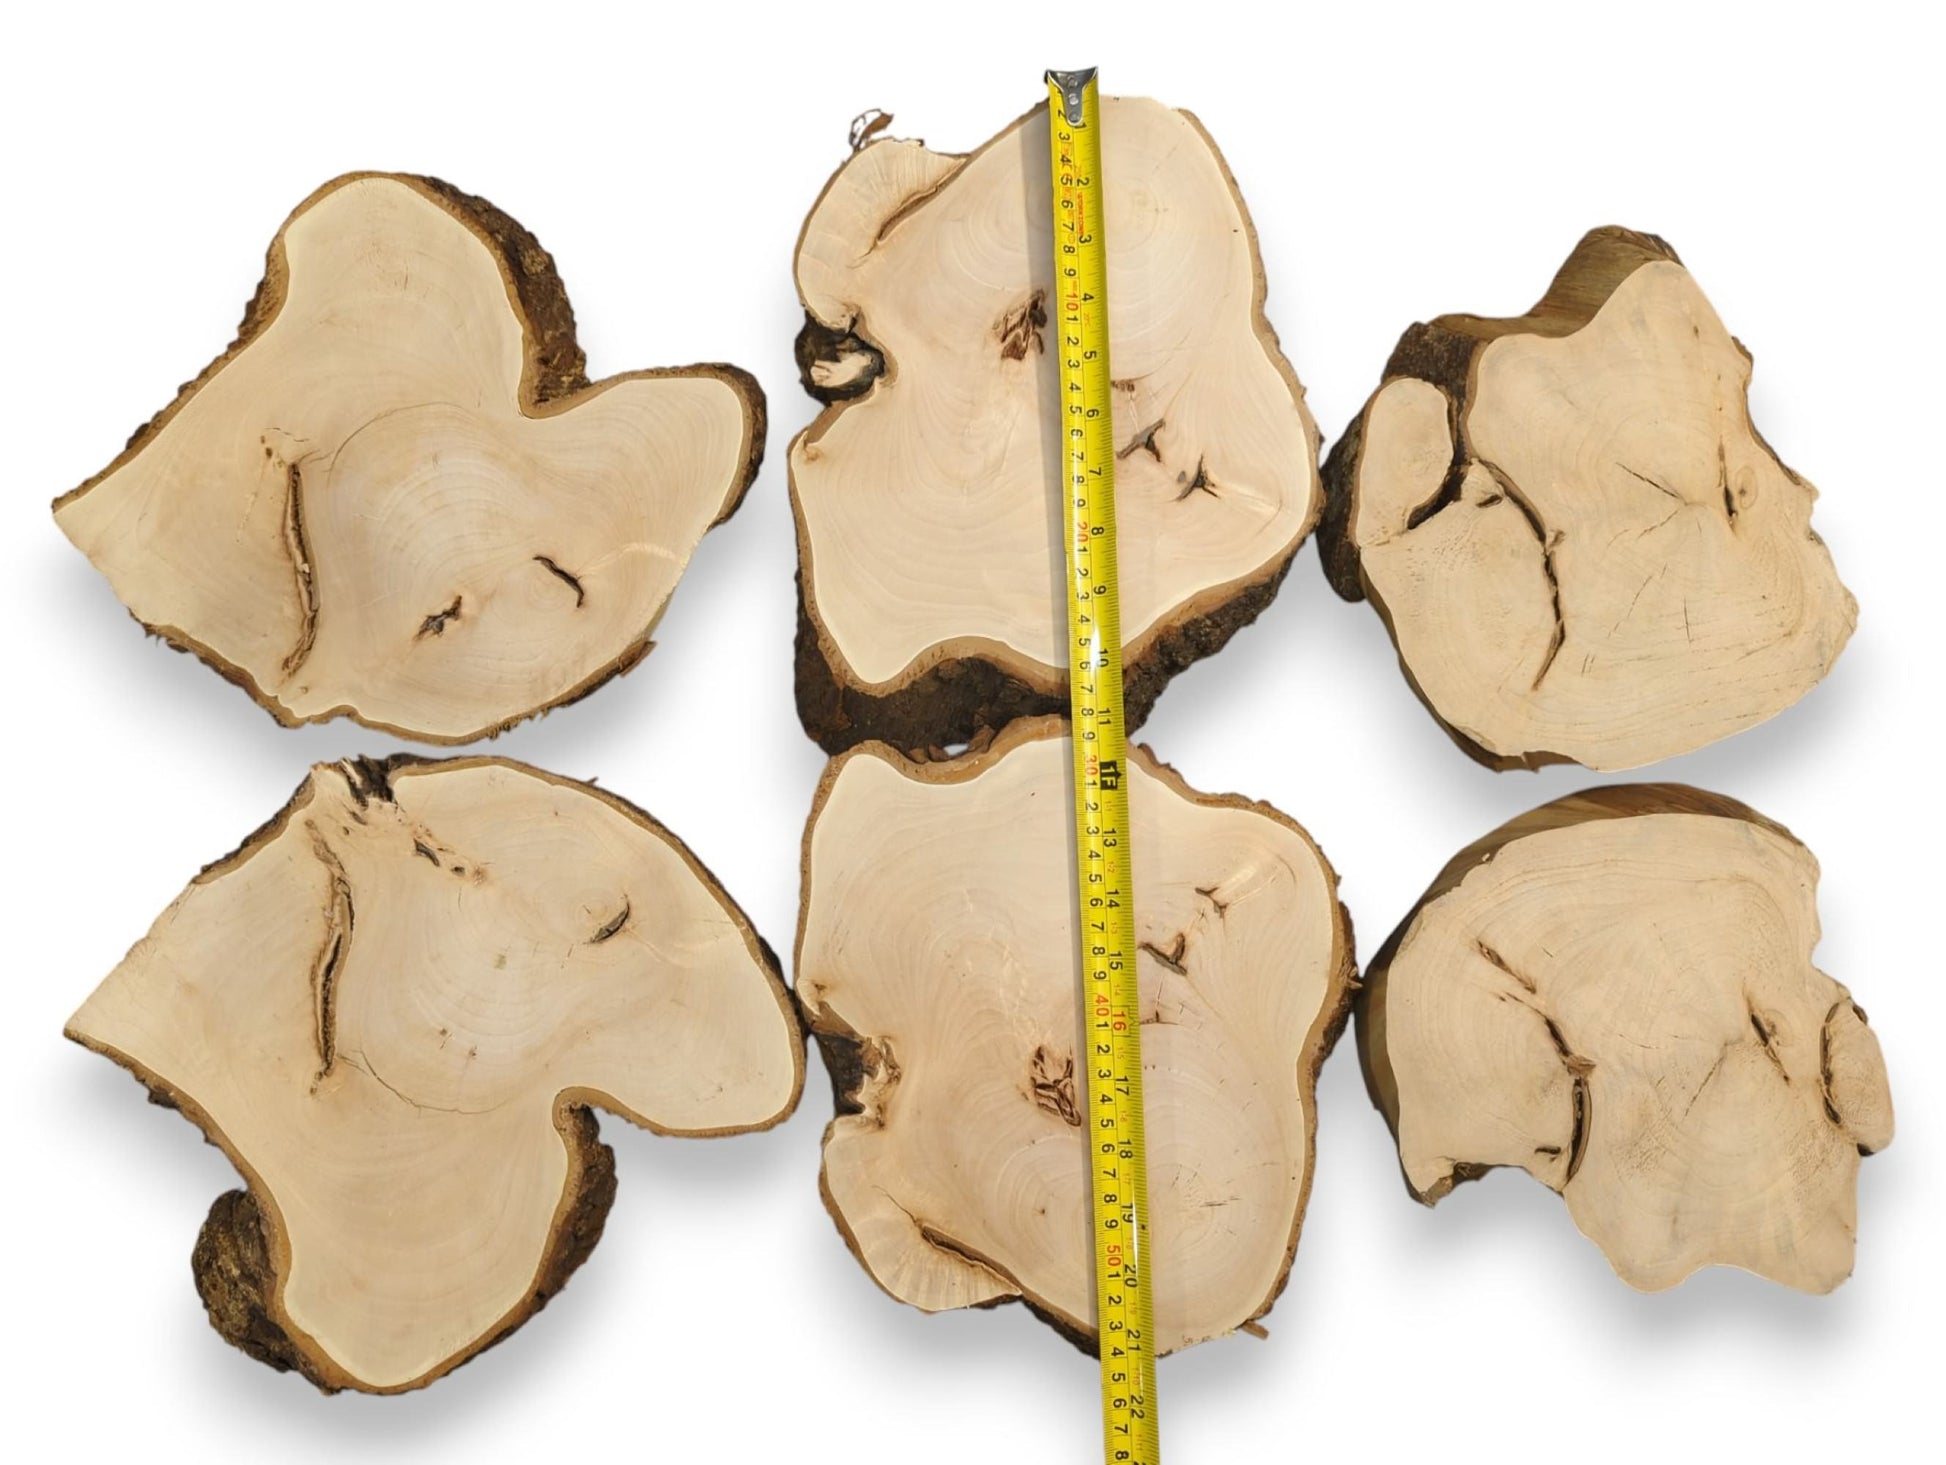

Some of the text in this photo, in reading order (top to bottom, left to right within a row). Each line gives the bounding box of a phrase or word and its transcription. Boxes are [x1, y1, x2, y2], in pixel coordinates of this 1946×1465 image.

[1058, 109, 1066, 120] 2
[1059, 133, 1070, 141] 3
[1060, 154, 1072, 164] 4
[1061, 177, 1072, 185] 5
[1077, 177, 1089, 186] 2
[1062, 200, 1073, 209] 6
[1063, 222, 1074, 232] 7
[1079, 235, 1091, 243] 3
[1064, 245, 1075, 253] 8
[1064, 269, 1076, 277] 9
[1082, 293, 1094, 301] 4
[1066, 293, 1078, 311] 10
[1067, 337, 1079, 345] 2
[1084, 351, 1096, 359] 5
[1068, 360, 1080, 368] 3
[1069, 383, 1081, 391] 4
[1070, 406, 1082, 414] 5
[1086, 409, 1099, 418] 6
[1071, 429, 1083, 437] 6
[1072, 452, 1083, 460] 7
[1089, 467, 1101, 475] 7
[1073, 499, 1086, 507] 9
[1077, 522, 1088, 542] 20
[1092, 526, 1104, 535] 8
[1077, 568, 1088, 576] 2
[1094, 585, 1106, 594] 9
[1077, 592, 1089, 600] 3
[1079, 615, 1091, 624] 4
[1079, 638, 1091, 646] 5
[1097, 649, 1109, 667] 10
[1080, 662, 1091, 670] 6
[1081, 685, 1093, 693] 7
[1082, 708, 1094, 716] 8
[1098, 708, 1111, 725] 11
[1083, 732, 1095, 740] 9
[1085, 755, 1098, 776] 30
[1085, 802, 1098, 811] 2
[1087, 827, 1099, 835] 3
[1104, 828, 1117, 847] 13
[1088, 850, 1101, 859] 4
[1089, 874, 1102, 882] 5
[1090, 898, 1103, 907] 6
[1106, 889, 1120, 908] 14
[1091, 922, 1104, 931] 7
[1092, 947, 1105, 955] 8
[1109, 951, 1123, 970] 15
[1093, 971, 1107, 980] 9
[1095, 995, 1109, 1016] 40
[1113, 1011, 1126, 1030] 16
[1097, 1045, 1110, 1053] 2
[1098, 1070, 1111, 1078] 3
[1116, 1075, 1129, 1096] 17
[1100, 1094, 1113, 1103] 4
[1100, 1119, 1114, 1128] 5
[1102, 1144, 1115, 1153] 6
[1118, 1139, 1133, 1159] 18
[1103, 1168, 1116, 1178] 7
[1104, 1194, 1117, 1203] 8
[1121, 1203, 1134, 1223] 19
[1105, 1219, 1118, 1229] 9
[1107, 1245, 1121, 1266] 50
[1124, 1264, 1138, 1287] 20
[1108, 1296, 1122, 1305] 2
[1109, 1321, 1123, 1330] 3
[1128, 1329, 1140, 1350] 21
[1111, 1347, 1124, 1356] 4
[1112, 1373, 1126, 1382] 5
[1113, 1399, 1127, 1408] 6
[1130, 1395, 1144, 1419] 22
[1114, 1424, 1128, 1433] 7
[1115, 1451, 1129, 1460] 8
